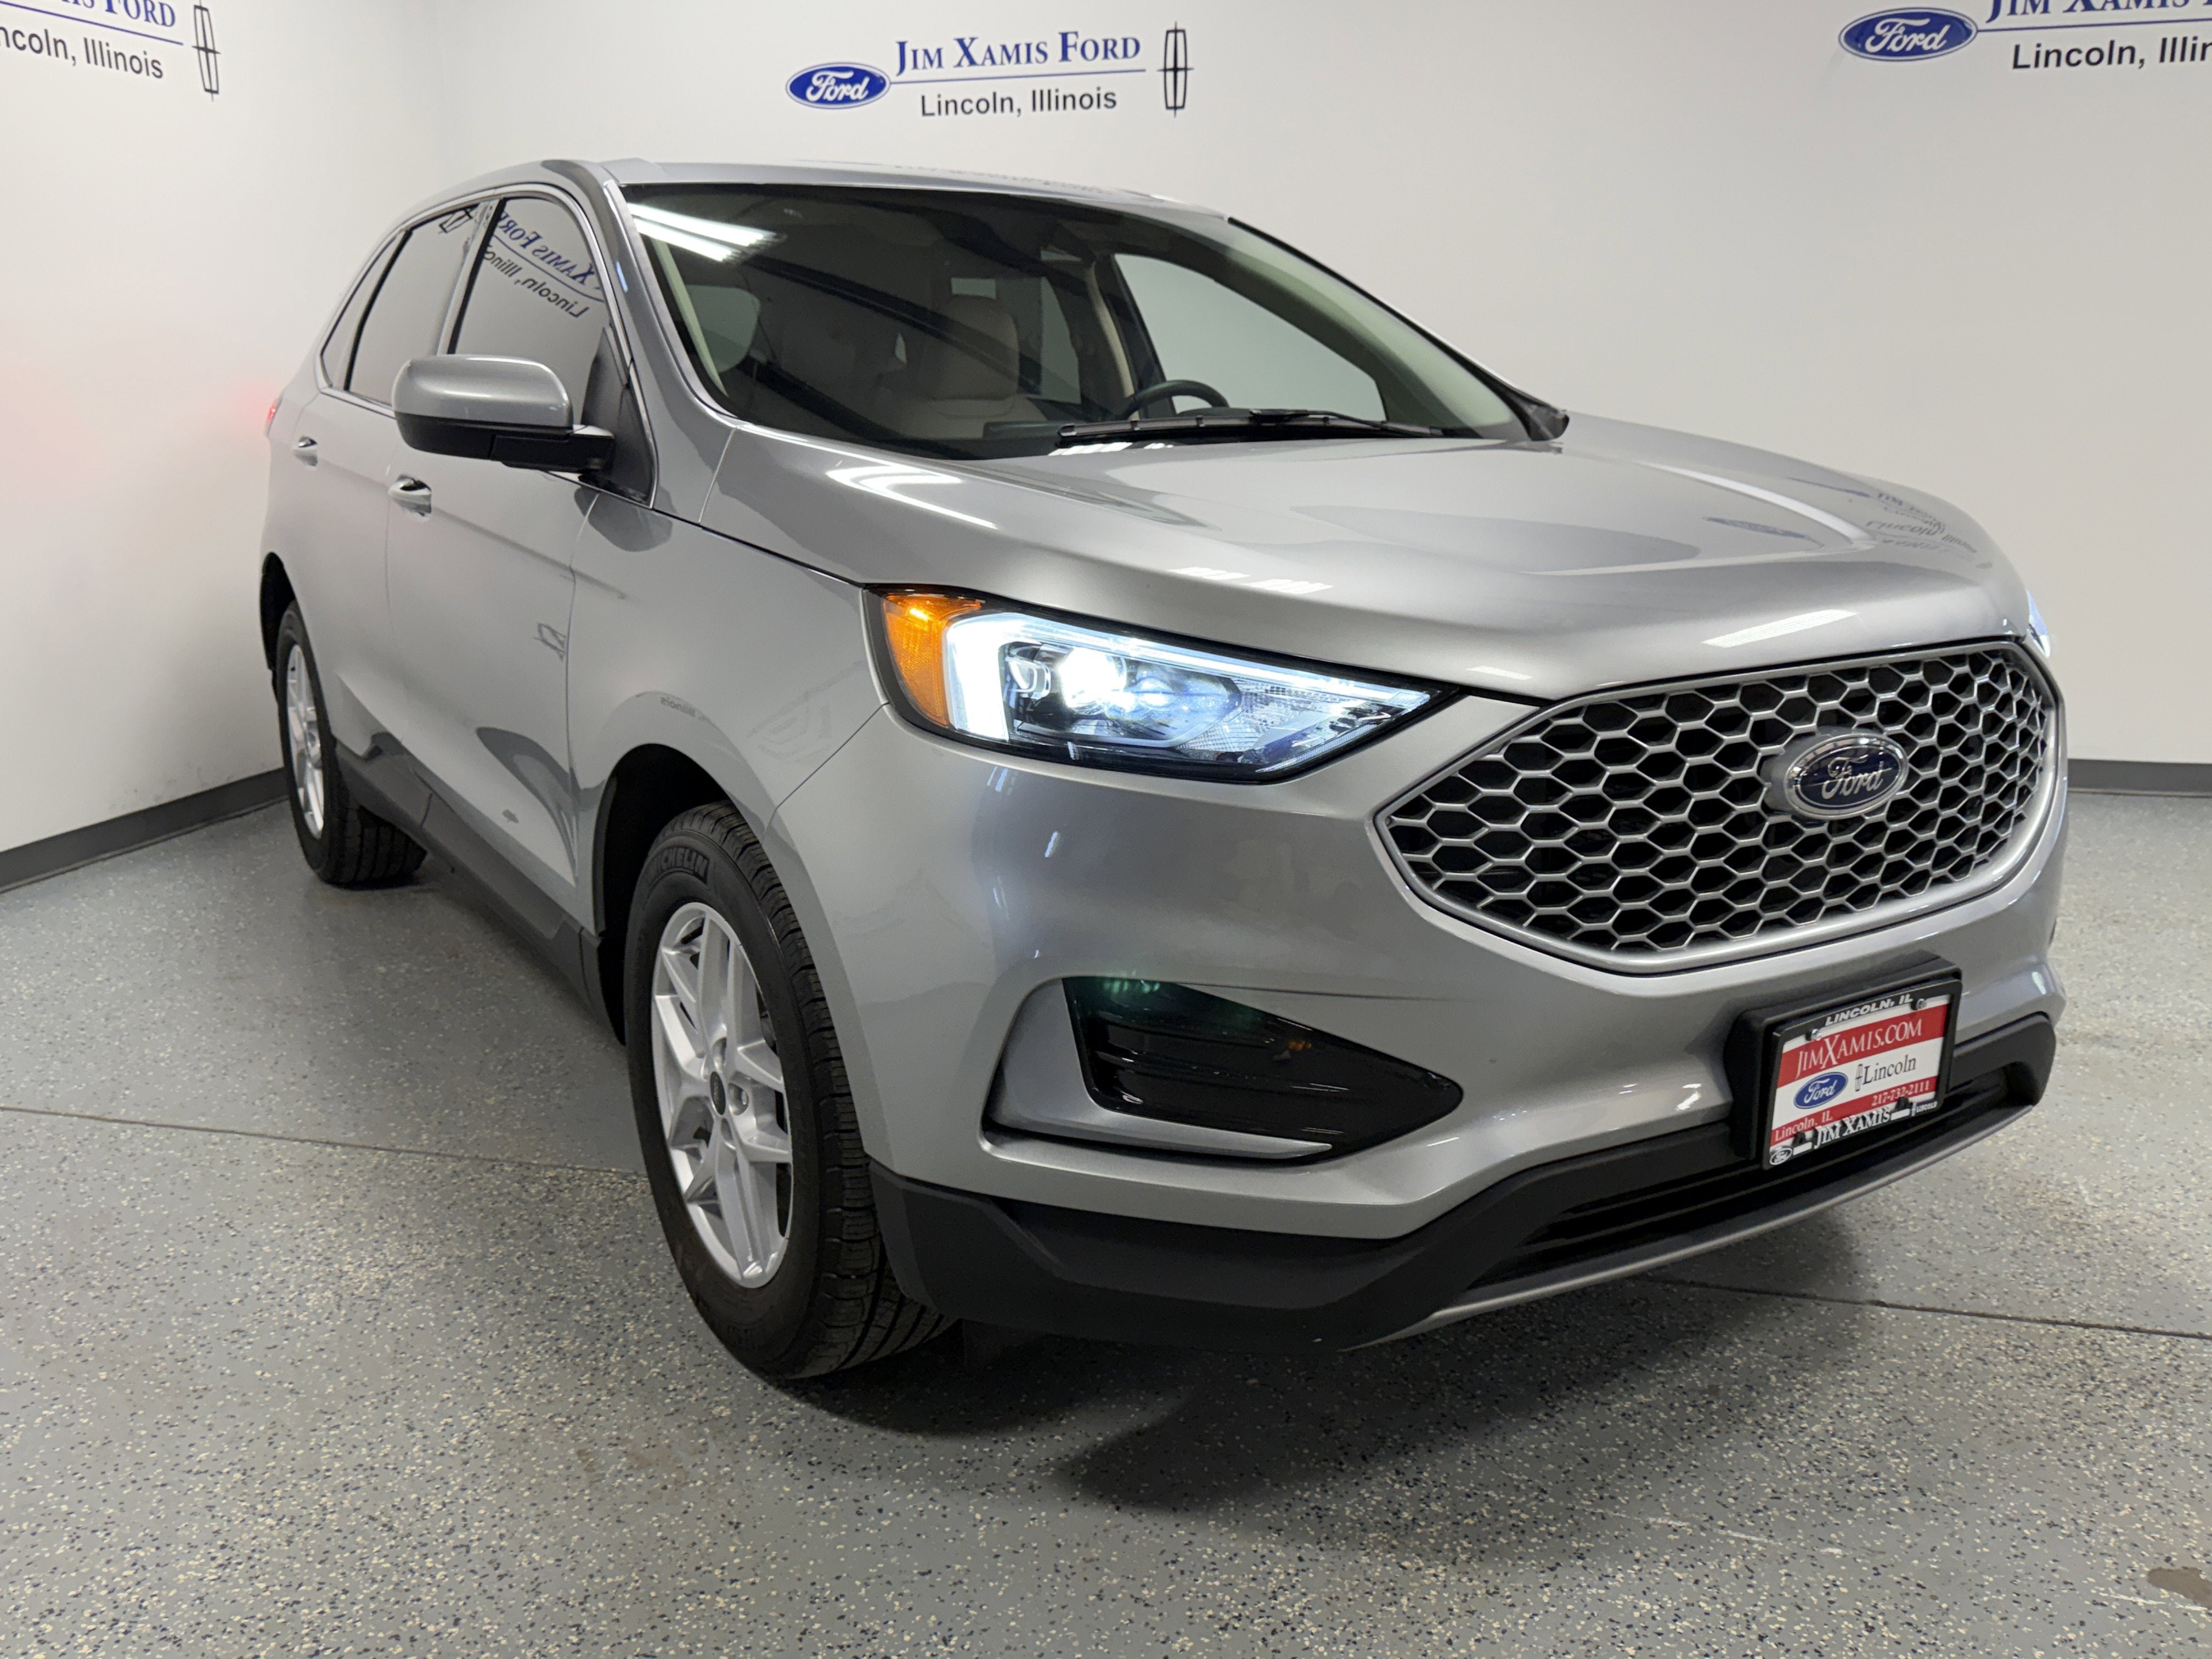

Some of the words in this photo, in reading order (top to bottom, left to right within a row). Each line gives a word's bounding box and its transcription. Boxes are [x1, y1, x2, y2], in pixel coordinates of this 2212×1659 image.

[1865, 18, 1951, 53] Ford
[0, 27, 76, 66] ncoln,
[84, 37, 163, 78] Illinois
[896, 41, 944, 76] JIM
[953, 37, 1048, 67] XAMIS
[1058, 31, 1141, 62] FORD
[2013, 40, 2145, 69] Lincoln,
[2159, 36, 2212, 63] Illin
[806, 71, 870, 101] Ford
[922, 91, 1022, 117] Lincoln,
[1032, 87, 1117, 112] Illinois
[1821, 754, 1885, 799] Ford
[1825, 998, 1894, 1026] LINCOLN,
[1899, 994, 1913, 1004] IL
[1796, 1019, 1922, 1079] JIMXAMIS.COM
[1863, 1054, 1916, 1085] Lincoln
[1804, 1078, 1837, 1104] Ford
[1871, 1080, 1930, 1107] 217-732-2111
[1814, 1122, 1840, 1149] JIM
[1842, 1108, 1891, 1137] XAMIS
[1821, 1110, 1833, 1124] IL
